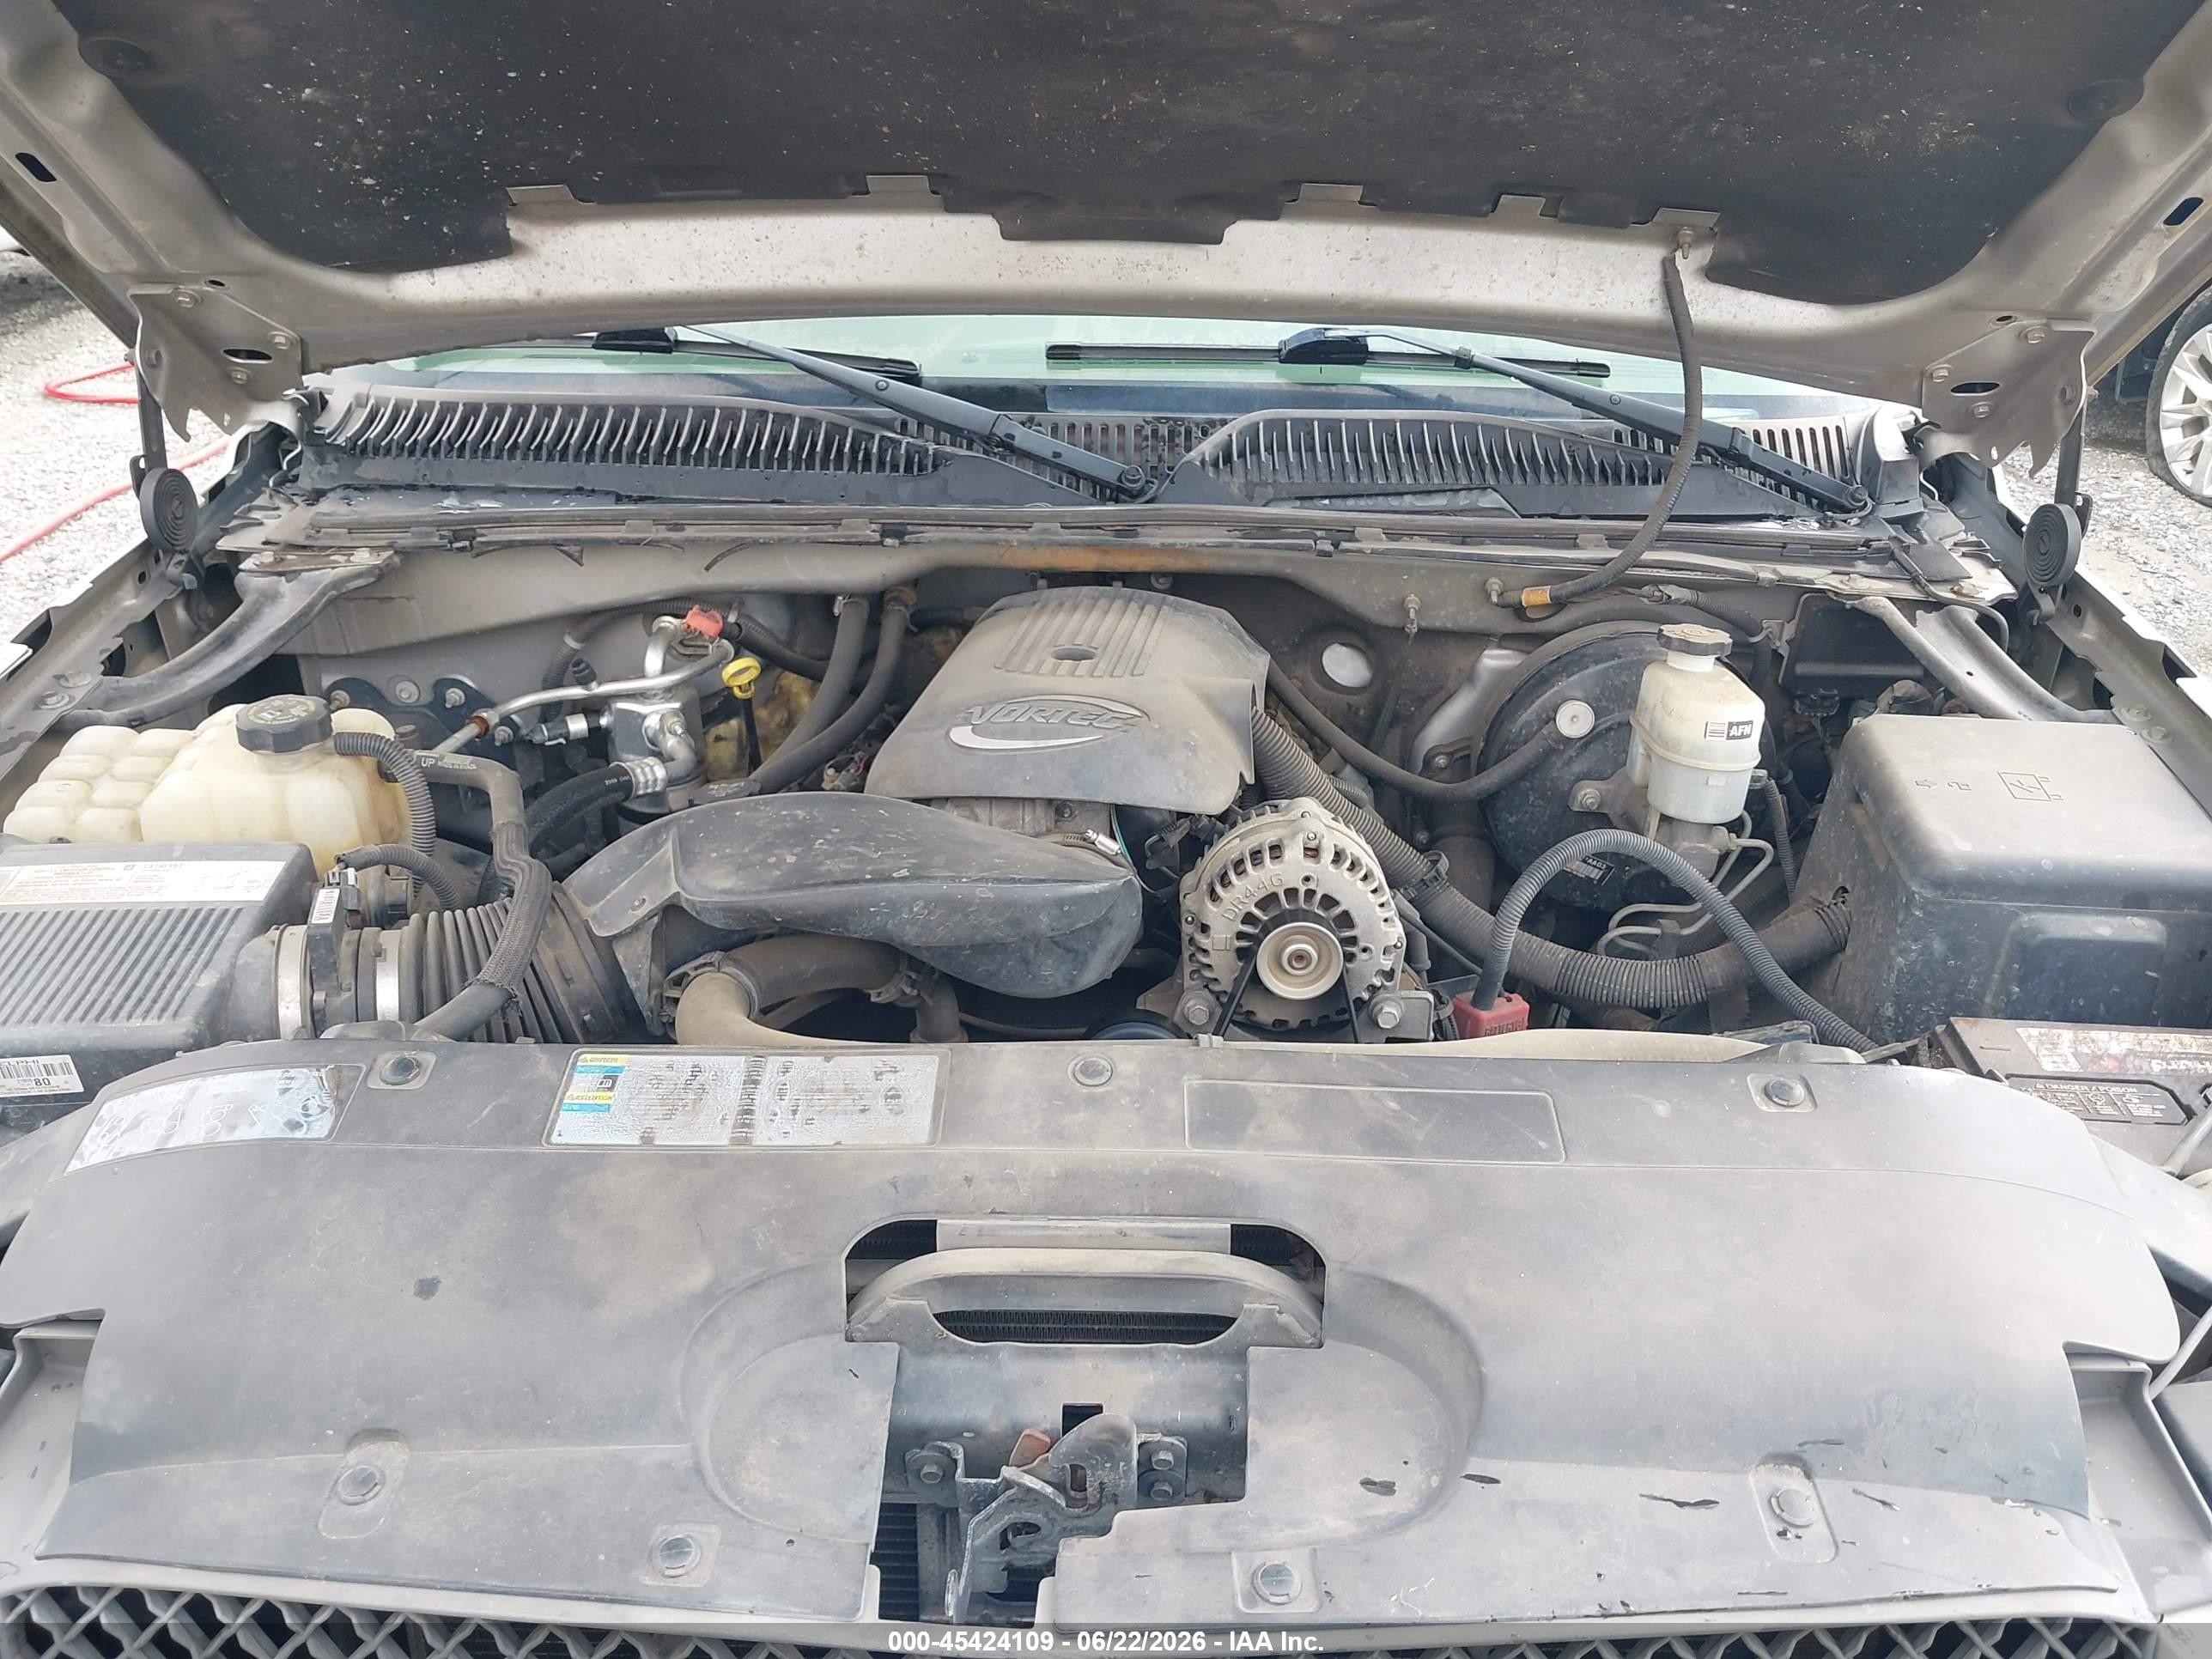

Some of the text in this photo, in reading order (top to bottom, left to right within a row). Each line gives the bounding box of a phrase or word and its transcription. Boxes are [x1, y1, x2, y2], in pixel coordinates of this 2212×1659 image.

[966, 703, 1132, 729] VORTEC
[1729, 724, 1752, 737] AFN
[421, 757, 435, 768] UP
[1221, 872, 1285, 921] DR44G
[33, 1077, 52, 1087] 80
[2045, 1083, 2089, 1091] DANGER
[2098, 1085, 2139, 1094] POISON
